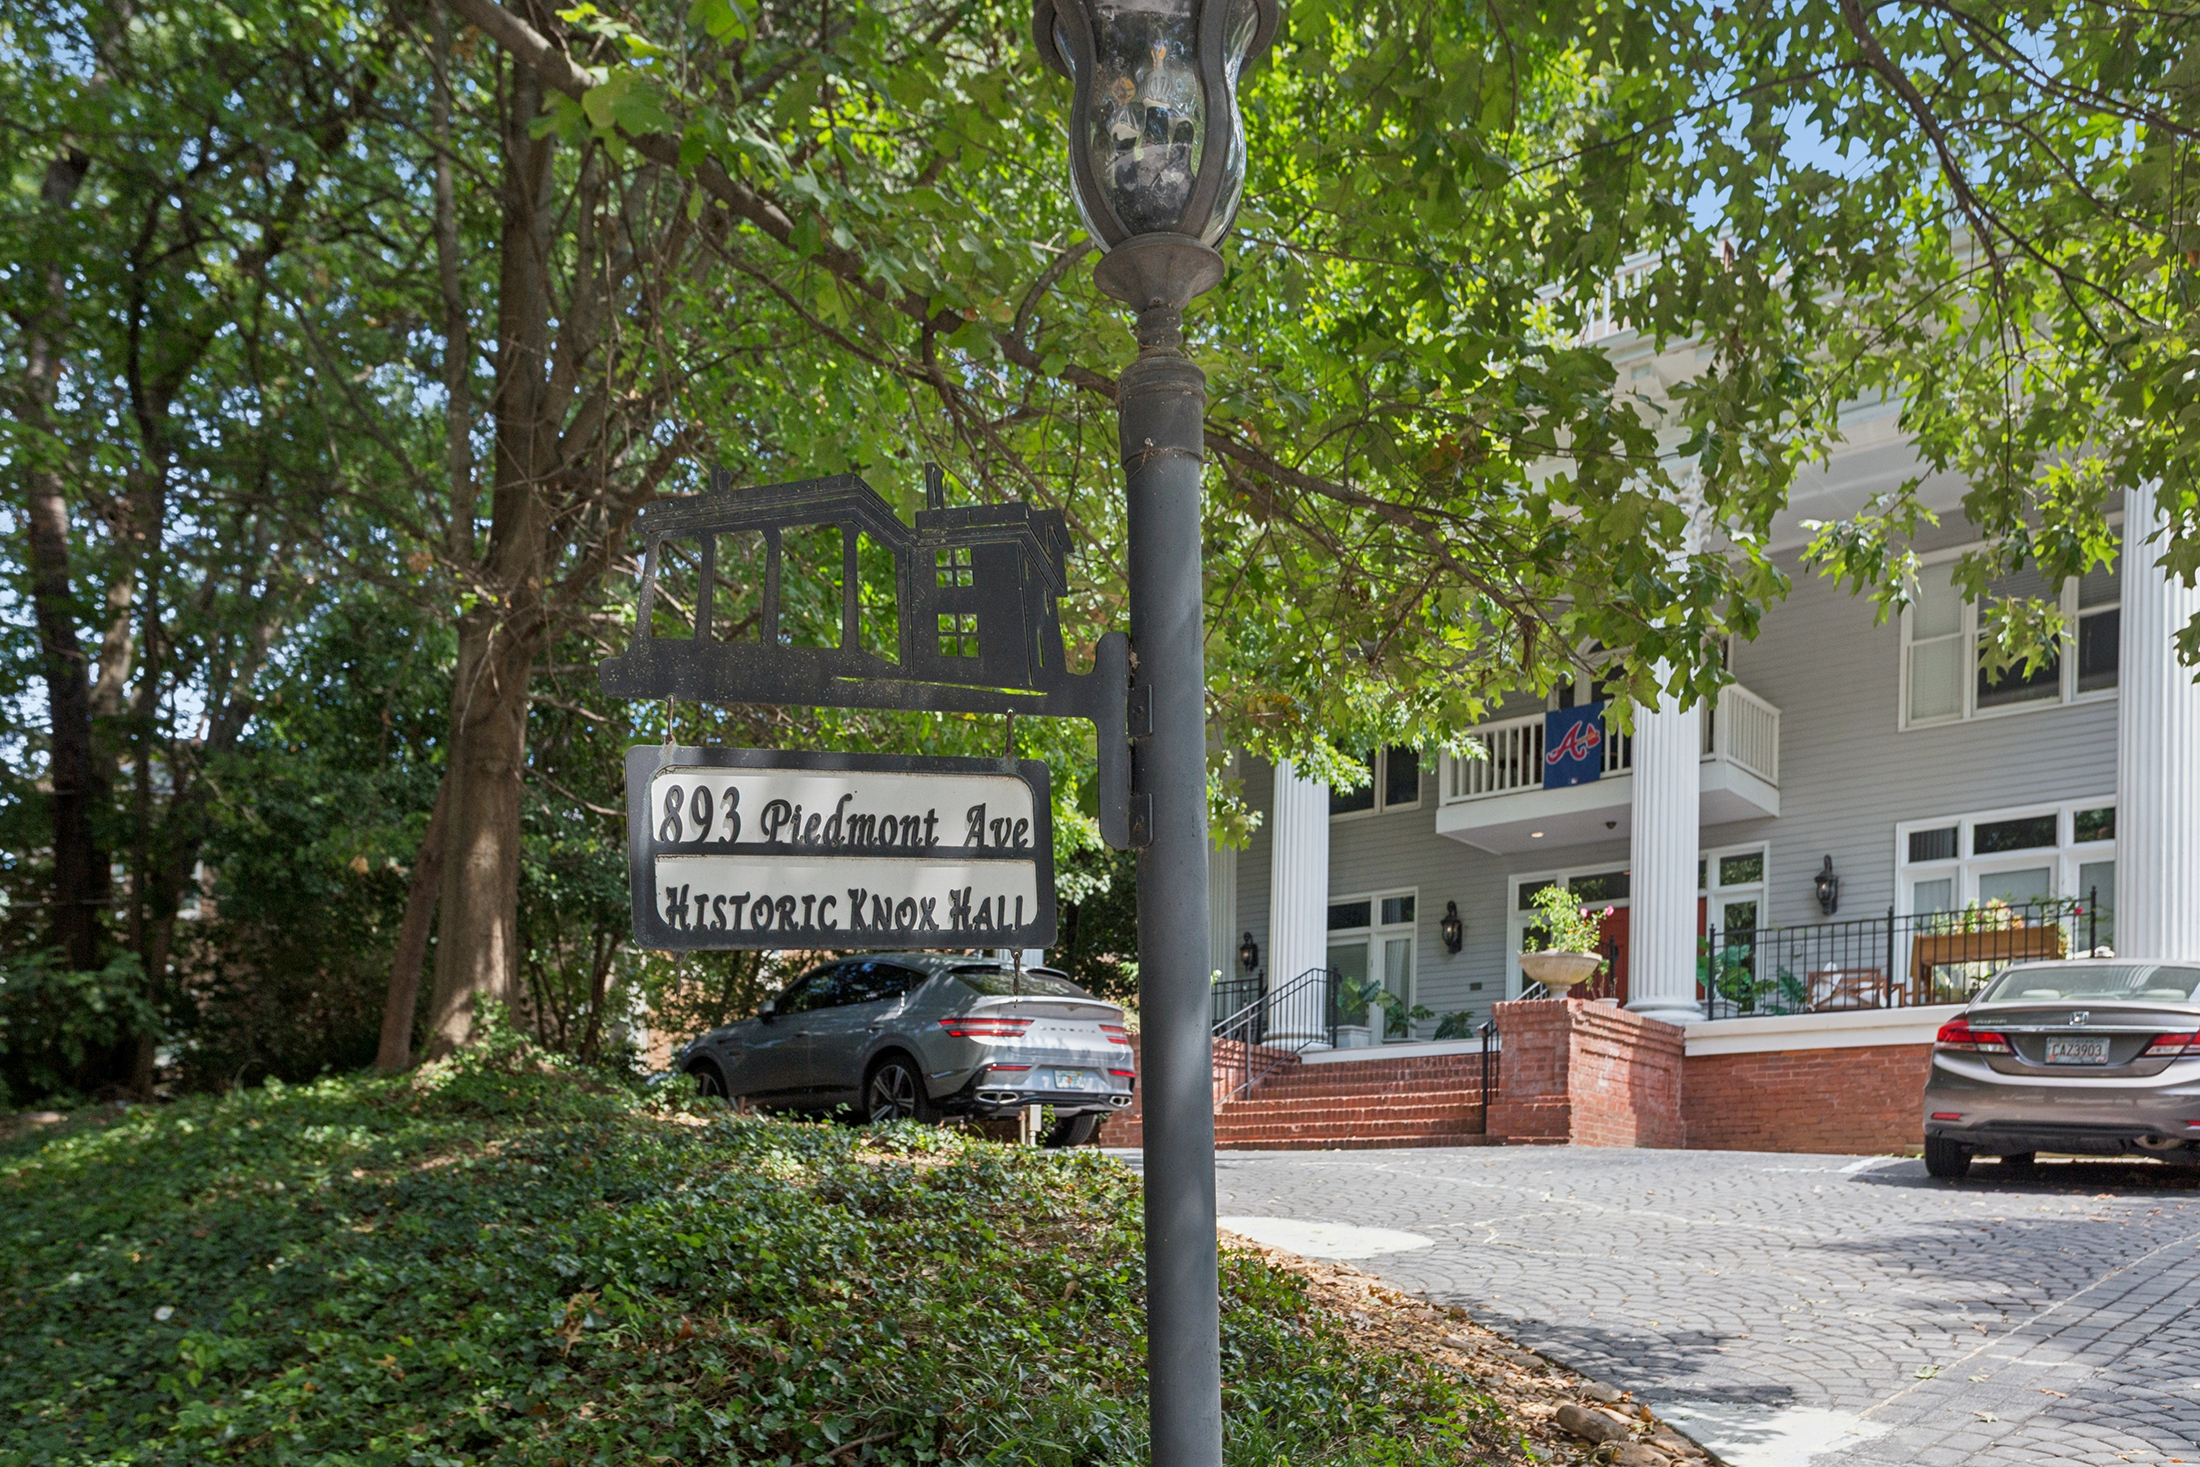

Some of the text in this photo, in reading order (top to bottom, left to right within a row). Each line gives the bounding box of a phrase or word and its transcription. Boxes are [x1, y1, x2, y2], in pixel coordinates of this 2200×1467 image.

[660, 784, 1029, 847] 893 Piedmont Ave
[665, 883, 838, 931] HISTORIC
[847, 887, 940, 931] KNOX
[2052, 1043, 2102, 1057] CAZ3903
